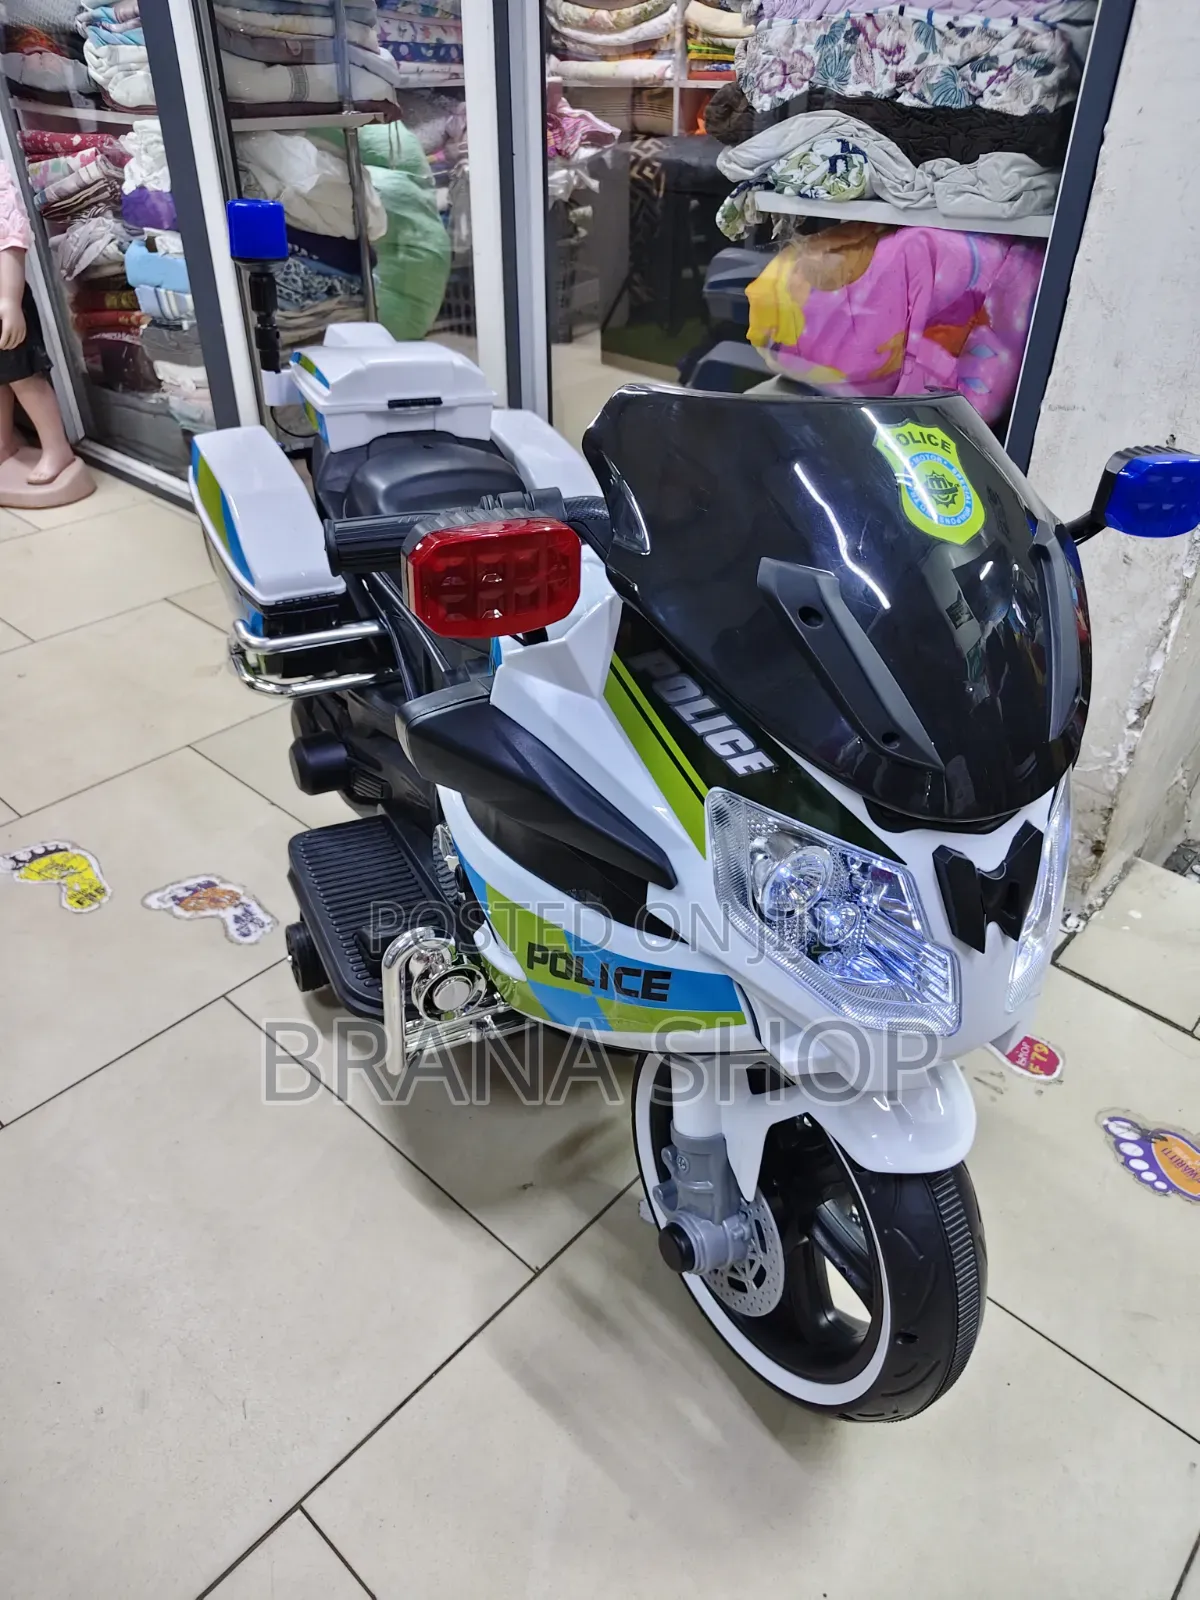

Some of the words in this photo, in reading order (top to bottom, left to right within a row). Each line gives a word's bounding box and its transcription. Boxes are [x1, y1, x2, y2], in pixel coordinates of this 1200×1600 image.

[912, 453, 942, 464] MOTOR
[626, 650, 778, 777] POLICE
[526, 941, 672, 1002] POLICE
